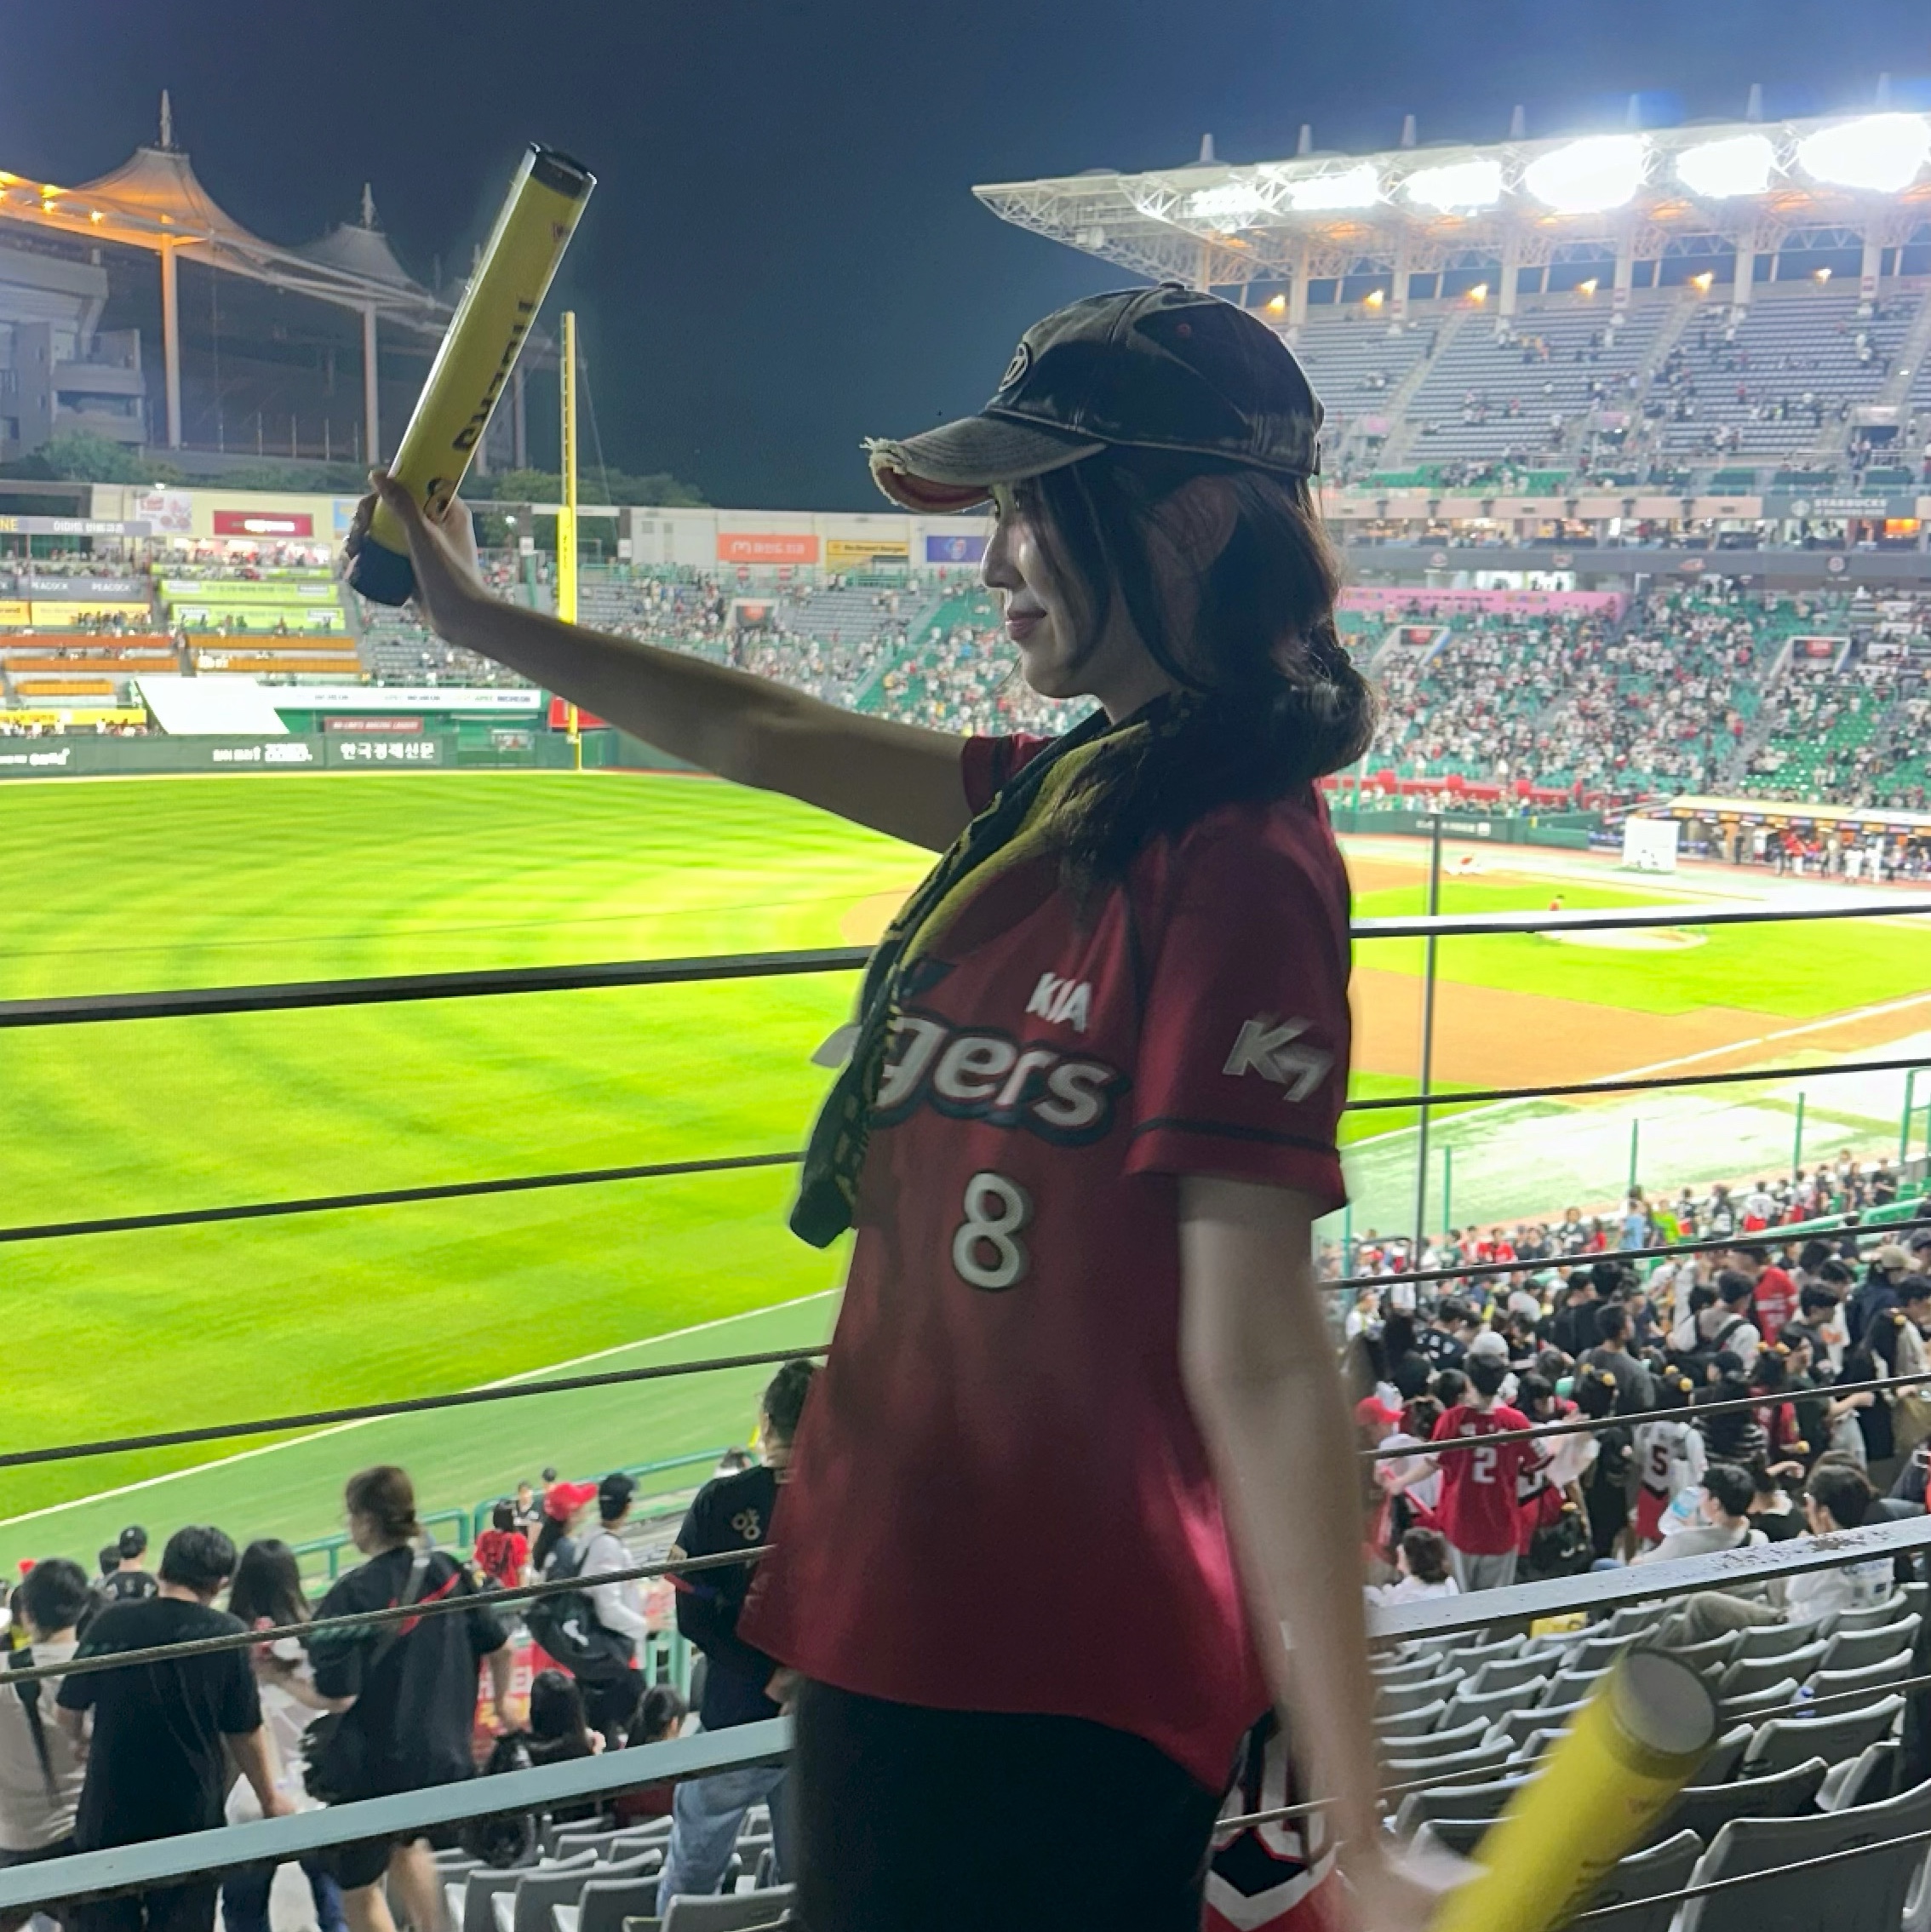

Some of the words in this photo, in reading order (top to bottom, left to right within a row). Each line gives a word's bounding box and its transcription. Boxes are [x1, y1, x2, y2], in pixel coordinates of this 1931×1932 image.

[1025, 972, 1091, 1033] KIA
[811, 1015, 1111, 1127] gers
[953, 1172, 1027, 1290] 8
[1472, 1447, 1497, 1483] 2
